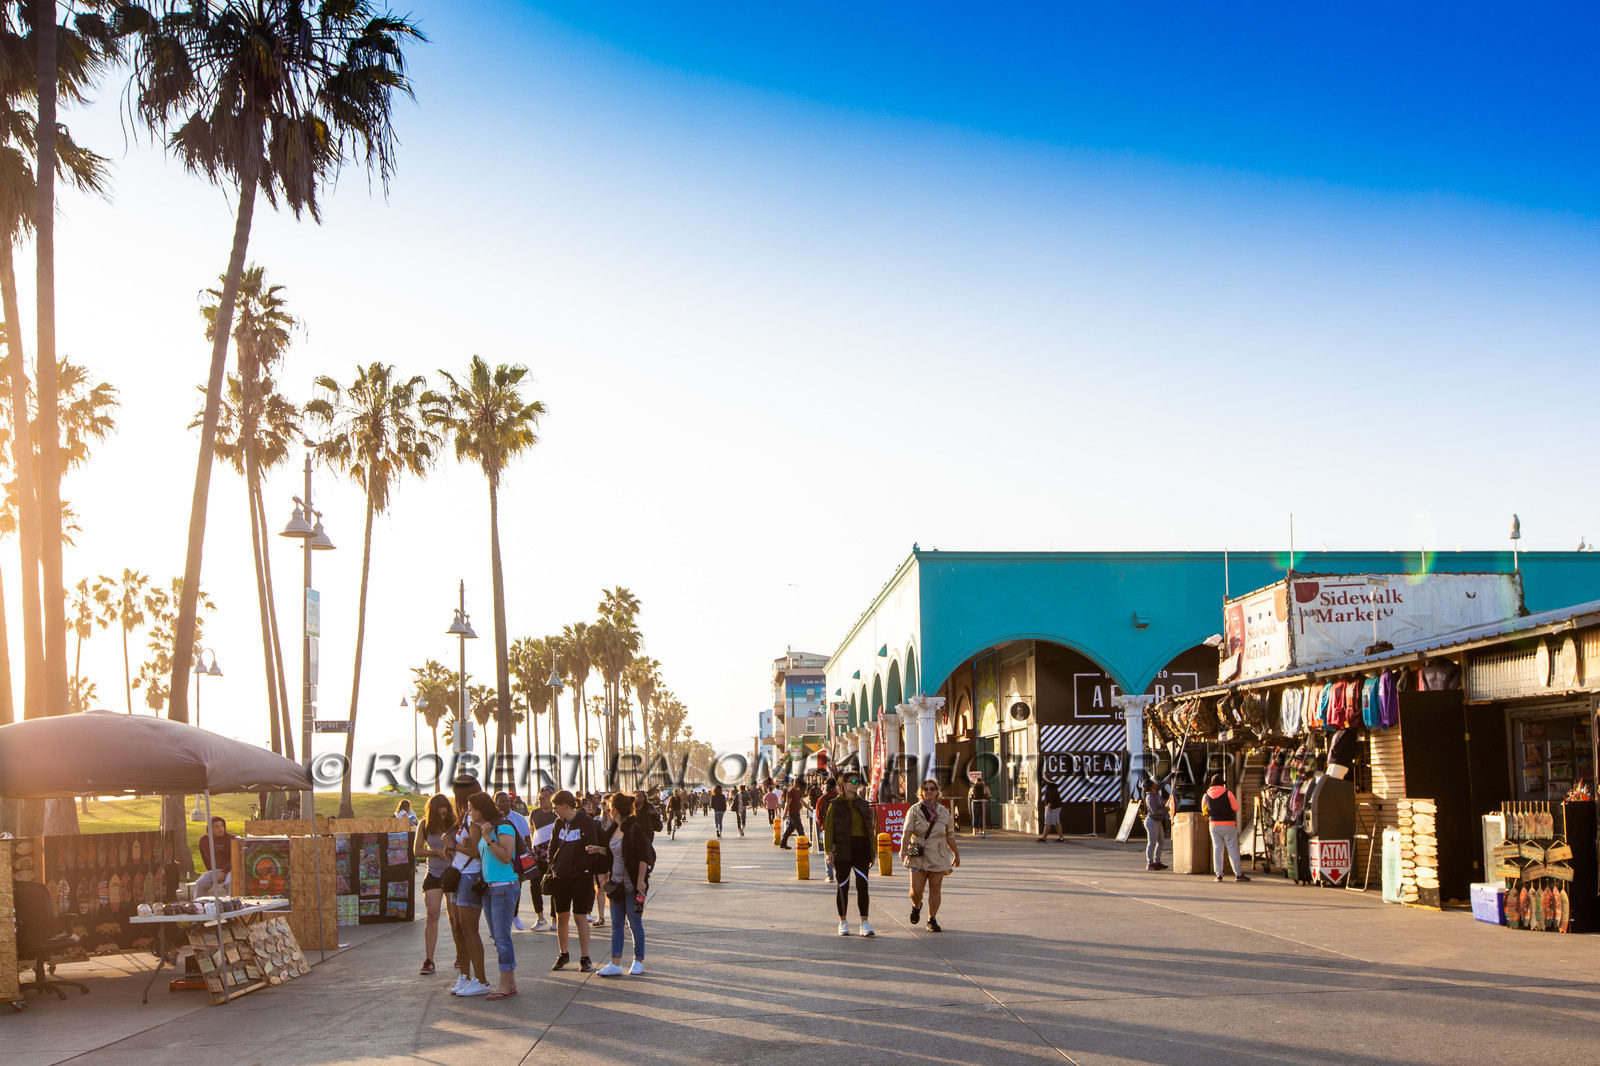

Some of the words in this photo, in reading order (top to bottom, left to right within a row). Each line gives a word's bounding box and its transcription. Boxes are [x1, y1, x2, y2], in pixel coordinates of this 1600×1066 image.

[1320, 589, 1404, 607] Sidewalk
[1316, 607, 1382, 623] Market
[316, 721, 338, 729] Market
[1043, 756, 1067, 773] ICE
[1321, 844, 1348, 860] ATM
[1322, 859, 1348, 867] HERE
